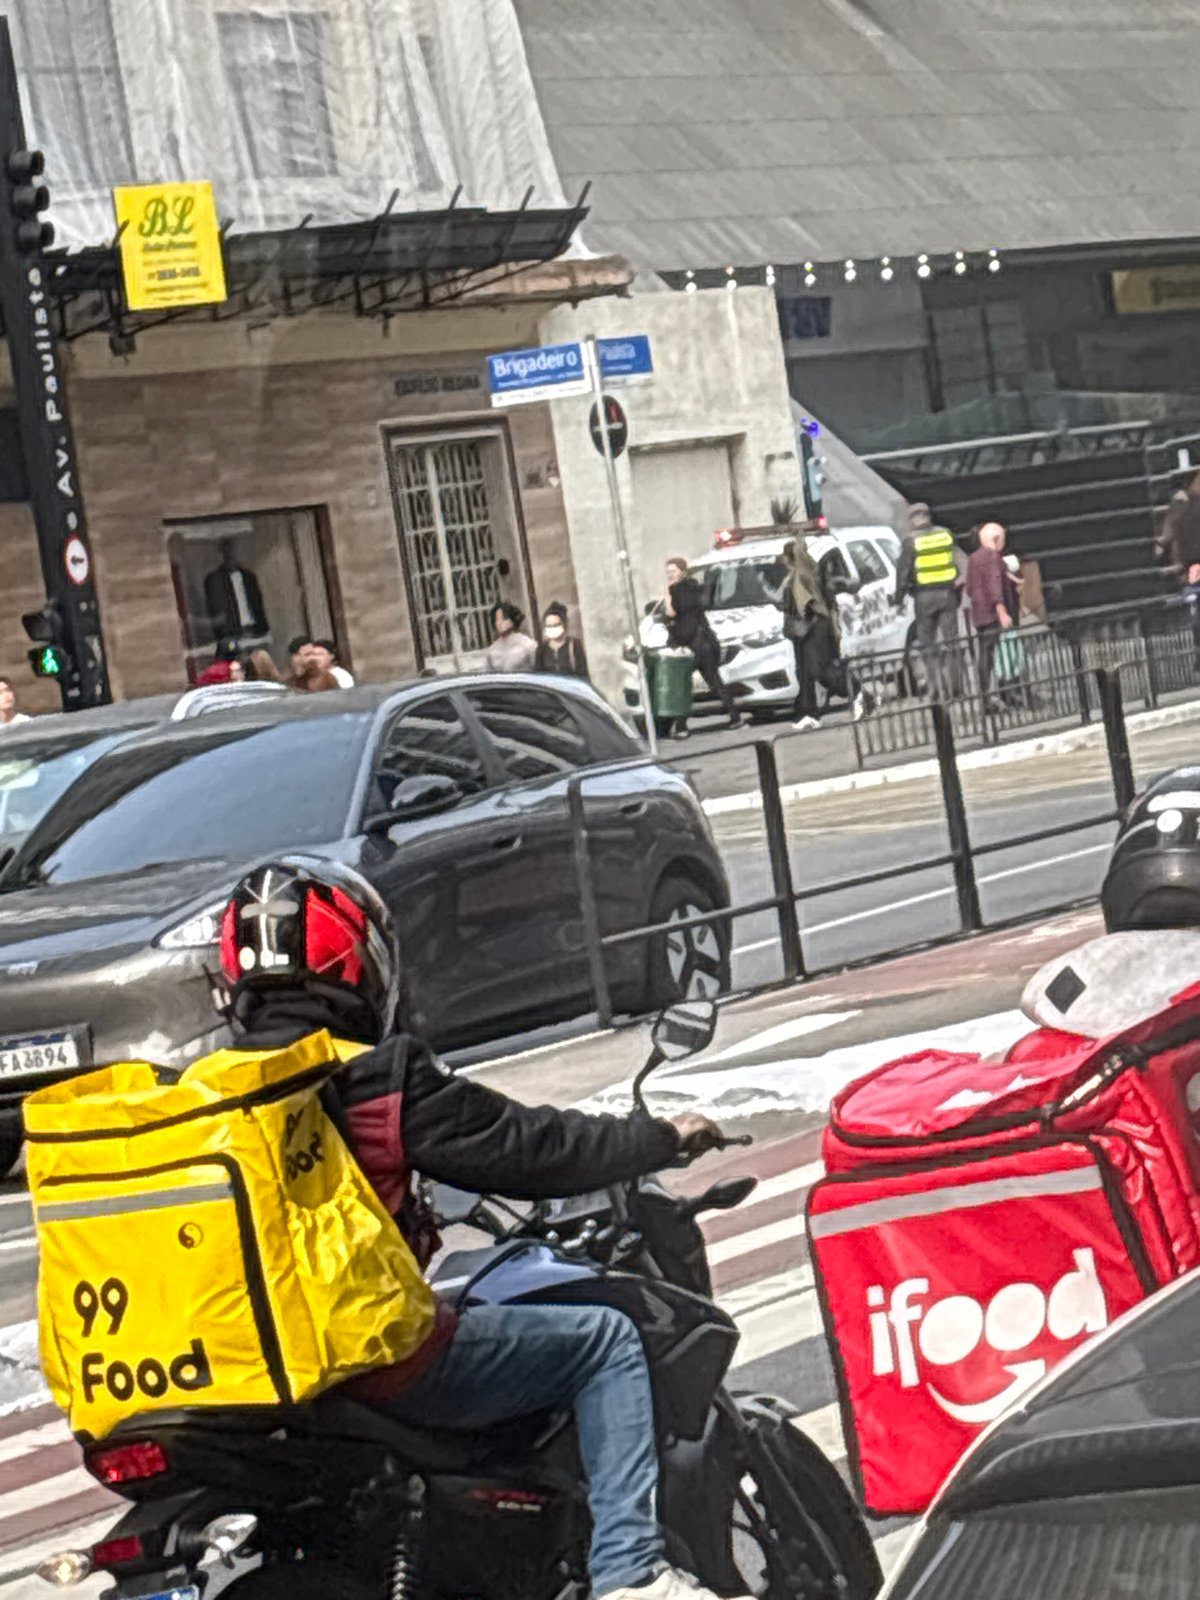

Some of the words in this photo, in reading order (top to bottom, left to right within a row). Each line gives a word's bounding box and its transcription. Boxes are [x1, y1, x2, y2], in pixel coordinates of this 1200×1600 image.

[28, 267, 62, 421] Paulista
[492, 350, 578, 377] Brigadeiro
[56, 437, 74, 497] Av.
[73, 1277, 129, 1337] 99
[867, 1247, 1107, 1388] ifood
[82, 1338, 213, 1404] Food
